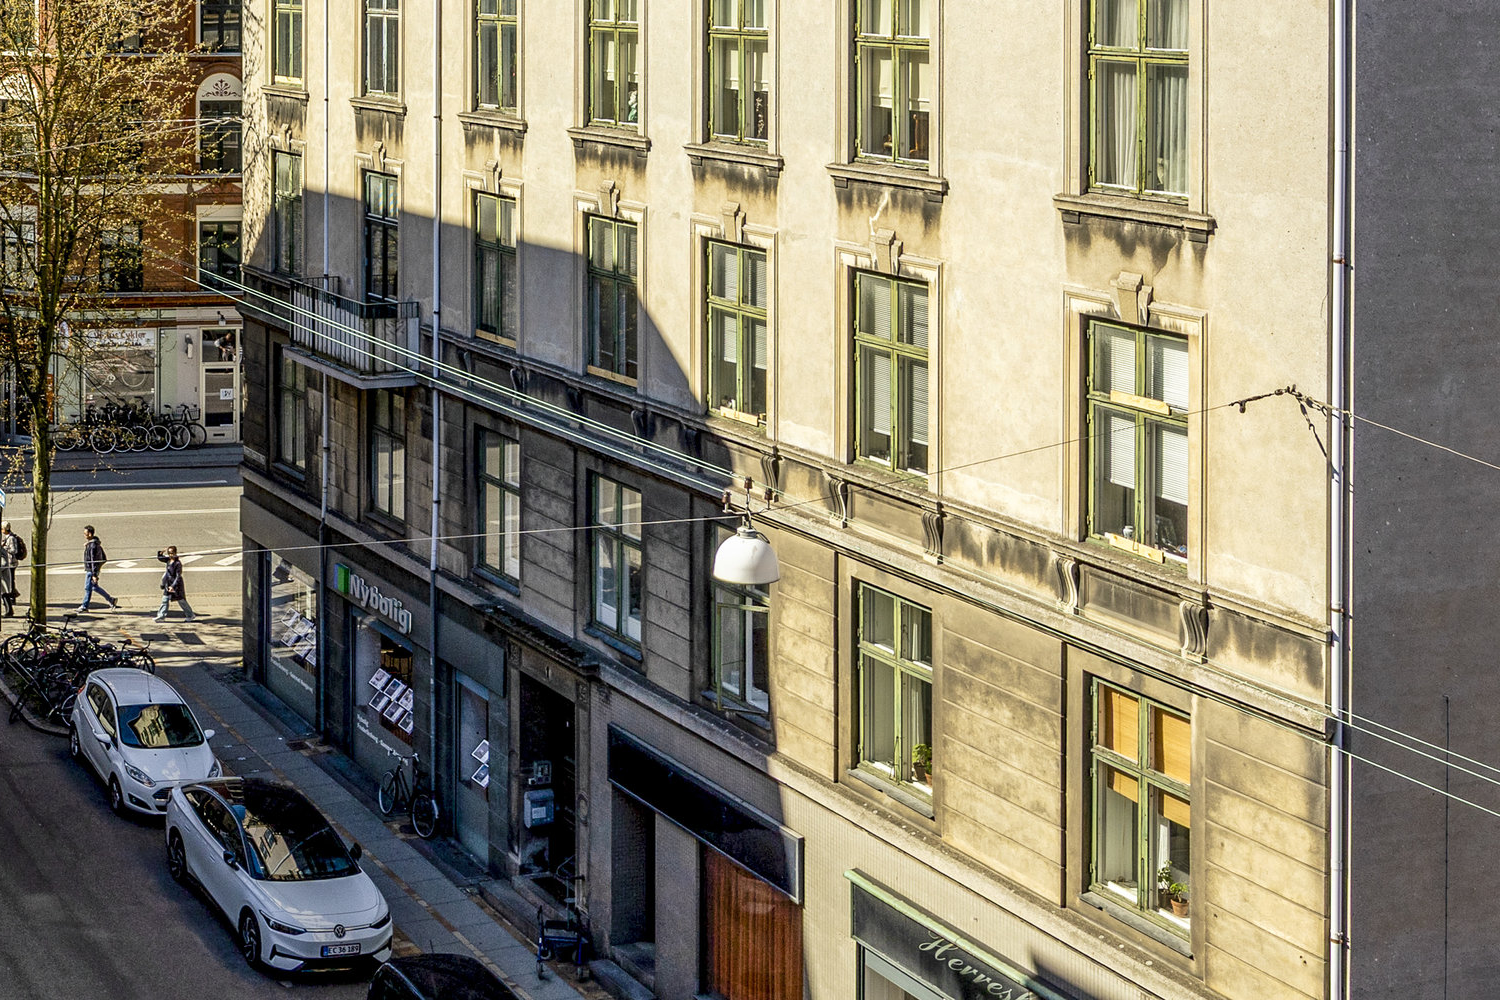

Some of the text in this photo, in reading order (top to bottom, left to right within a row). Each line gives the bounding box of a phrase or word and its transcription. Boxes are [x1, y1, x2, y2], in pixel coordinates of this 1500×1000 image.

[350, 574, 411, 634] Nybolig
[347, 945, 359, 953] 189
[918, 930, 1033, 1000] Herres
